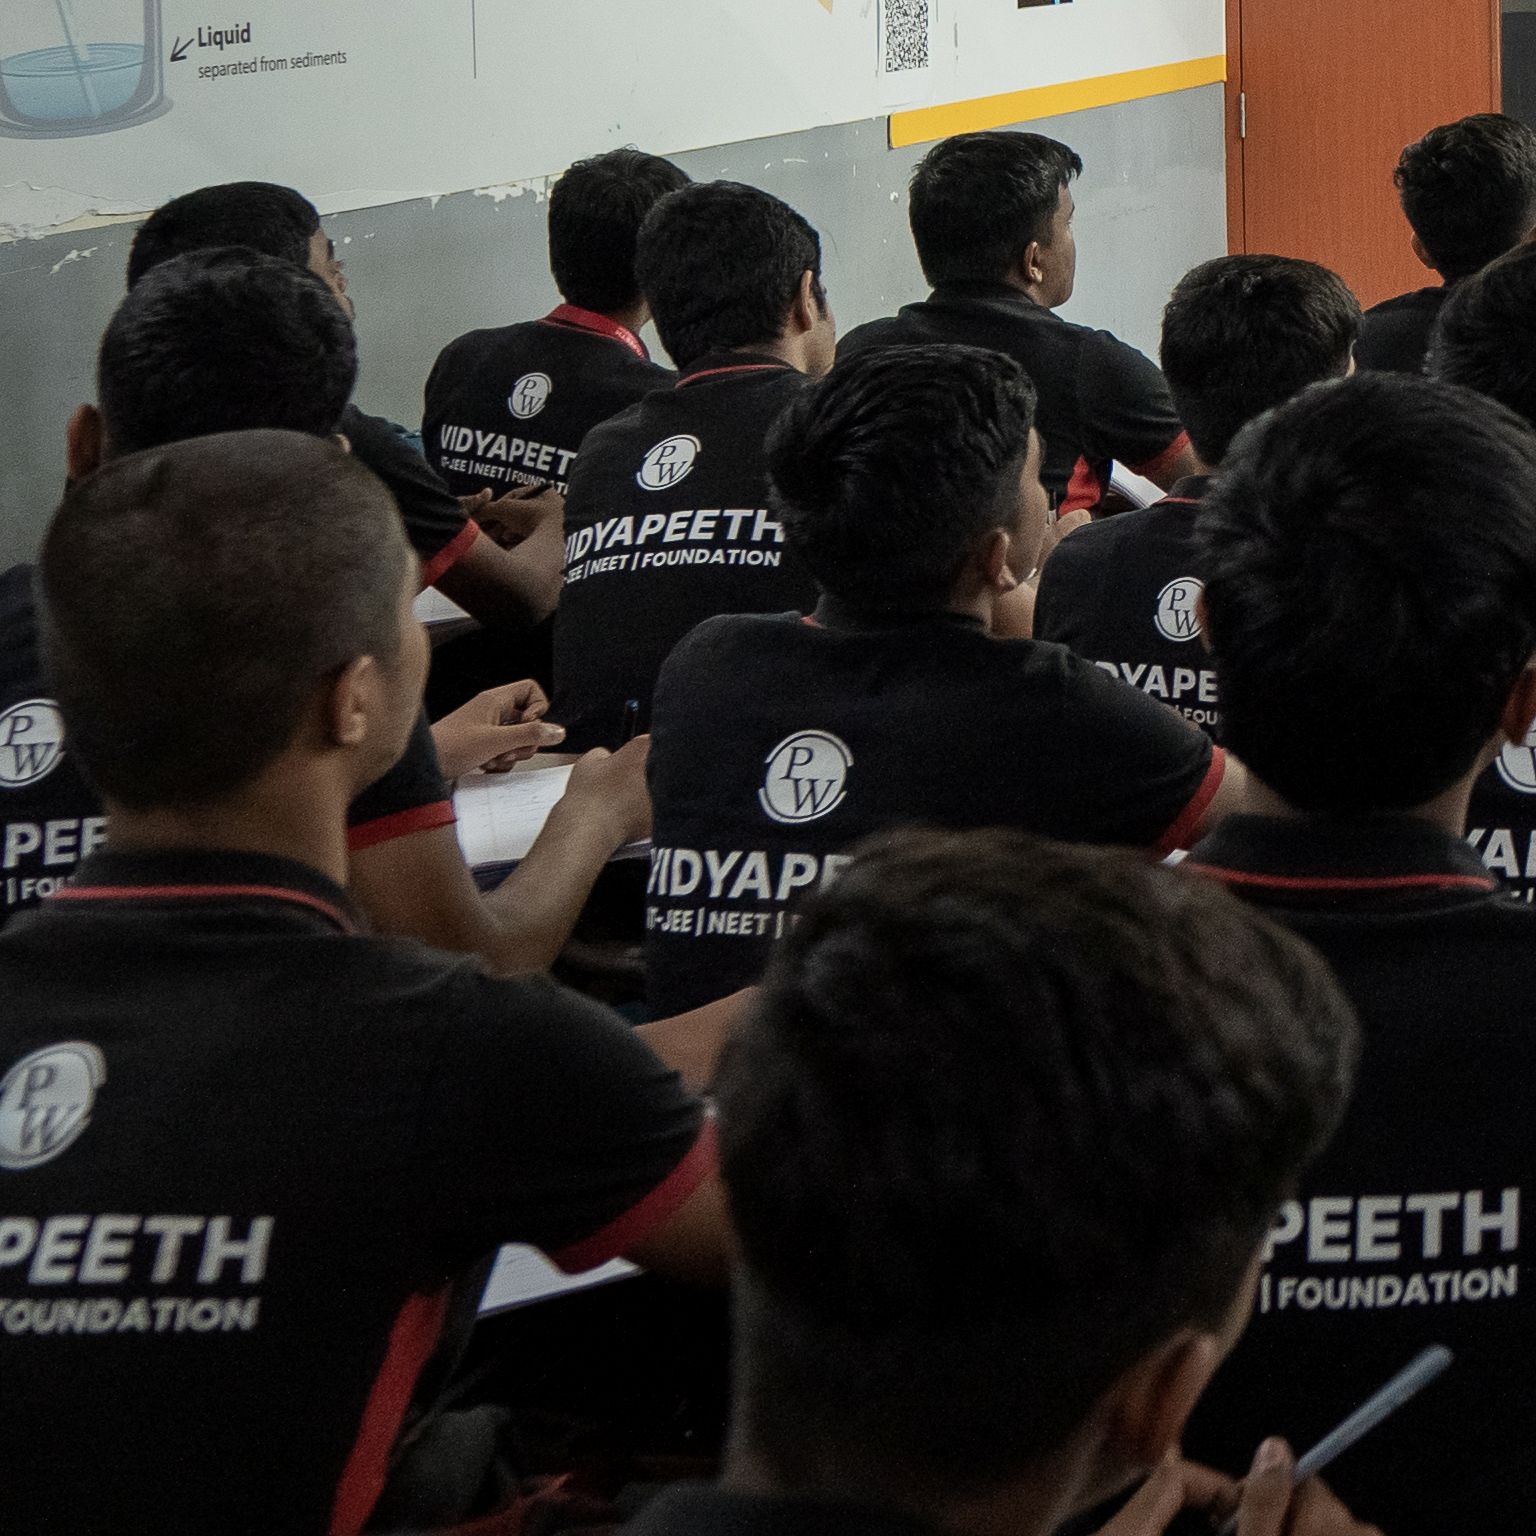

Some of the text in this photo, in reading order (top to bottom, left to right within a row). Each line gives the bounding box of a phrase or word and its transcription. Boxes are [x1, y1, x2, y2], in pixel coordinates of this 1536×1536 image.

[198, 22, 251, 51] Liquid
[198, 50, 347, 81] separated from sediments
[440, 424, 578, 476] VIDYAPEET
[473, 463, 505, 479] NEET
[565, 509, 786, 563] IDYAPEETH
[590, 554, 630, 575] NEET
[641, 548, 782, 568] FOUNDATION
[775, 743, 841, 818] PW
[706, 910, 771, 936] NEET
[1260, 1186, 1520, 1263] PEETH
[0, 1215, 275, 1285] PEETH
[1277, 1264, 1519, 1310] FOUNDATION
[0, 1296, 261, 1334] OUNDATION
